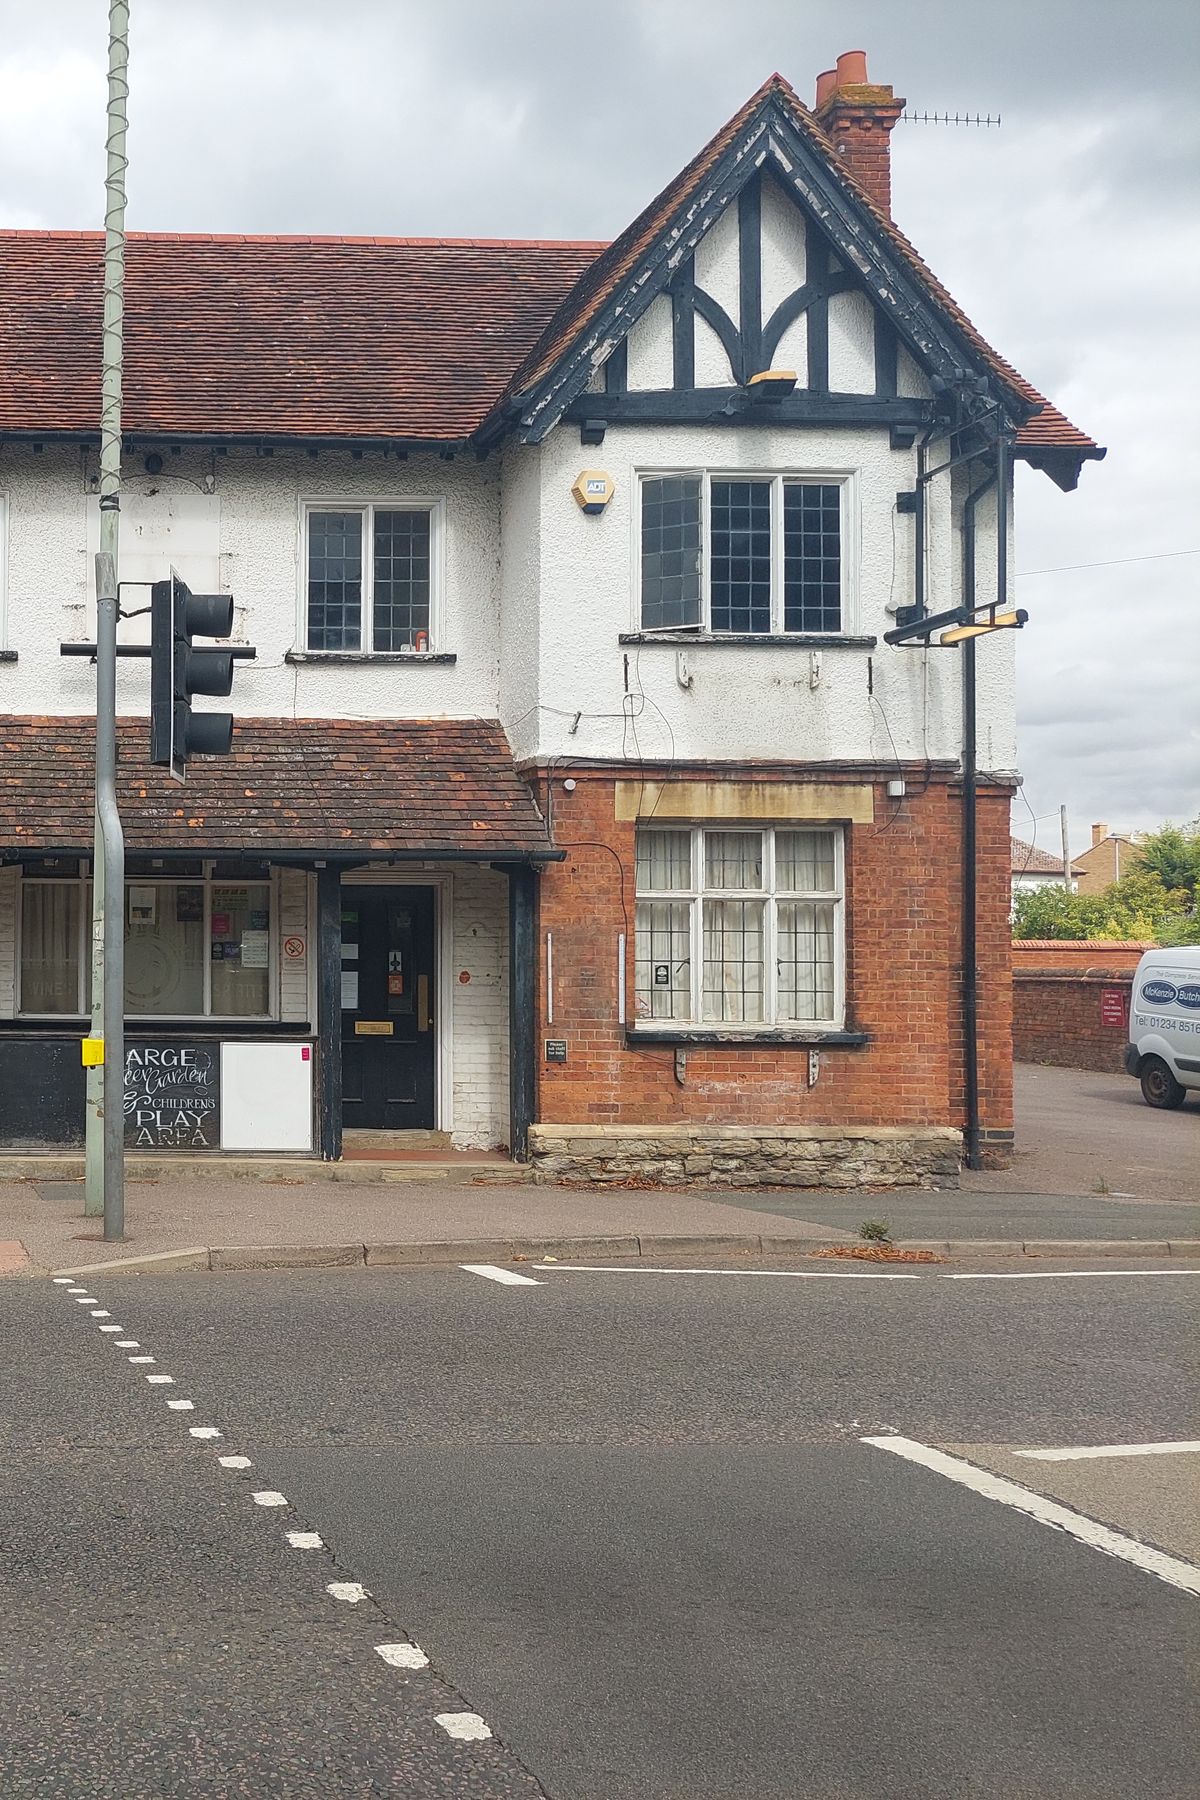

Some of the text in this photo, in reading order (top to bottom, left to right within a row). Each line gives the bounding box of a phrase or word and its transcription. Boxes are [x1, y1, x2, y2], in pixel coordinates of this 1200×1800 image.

[587, 482, 607, 492] ADT
[1144, 986, 1174, 999] McKenzie
[1150, 1017, 1177, 1030] 01234
[125, 1048, 196, 1067] ARGE
[124, 1066, 214, 1095] eer Garden
[135, 1110, 211, 1128] PLAY
[135, 1127, 210, 1146] AREA
